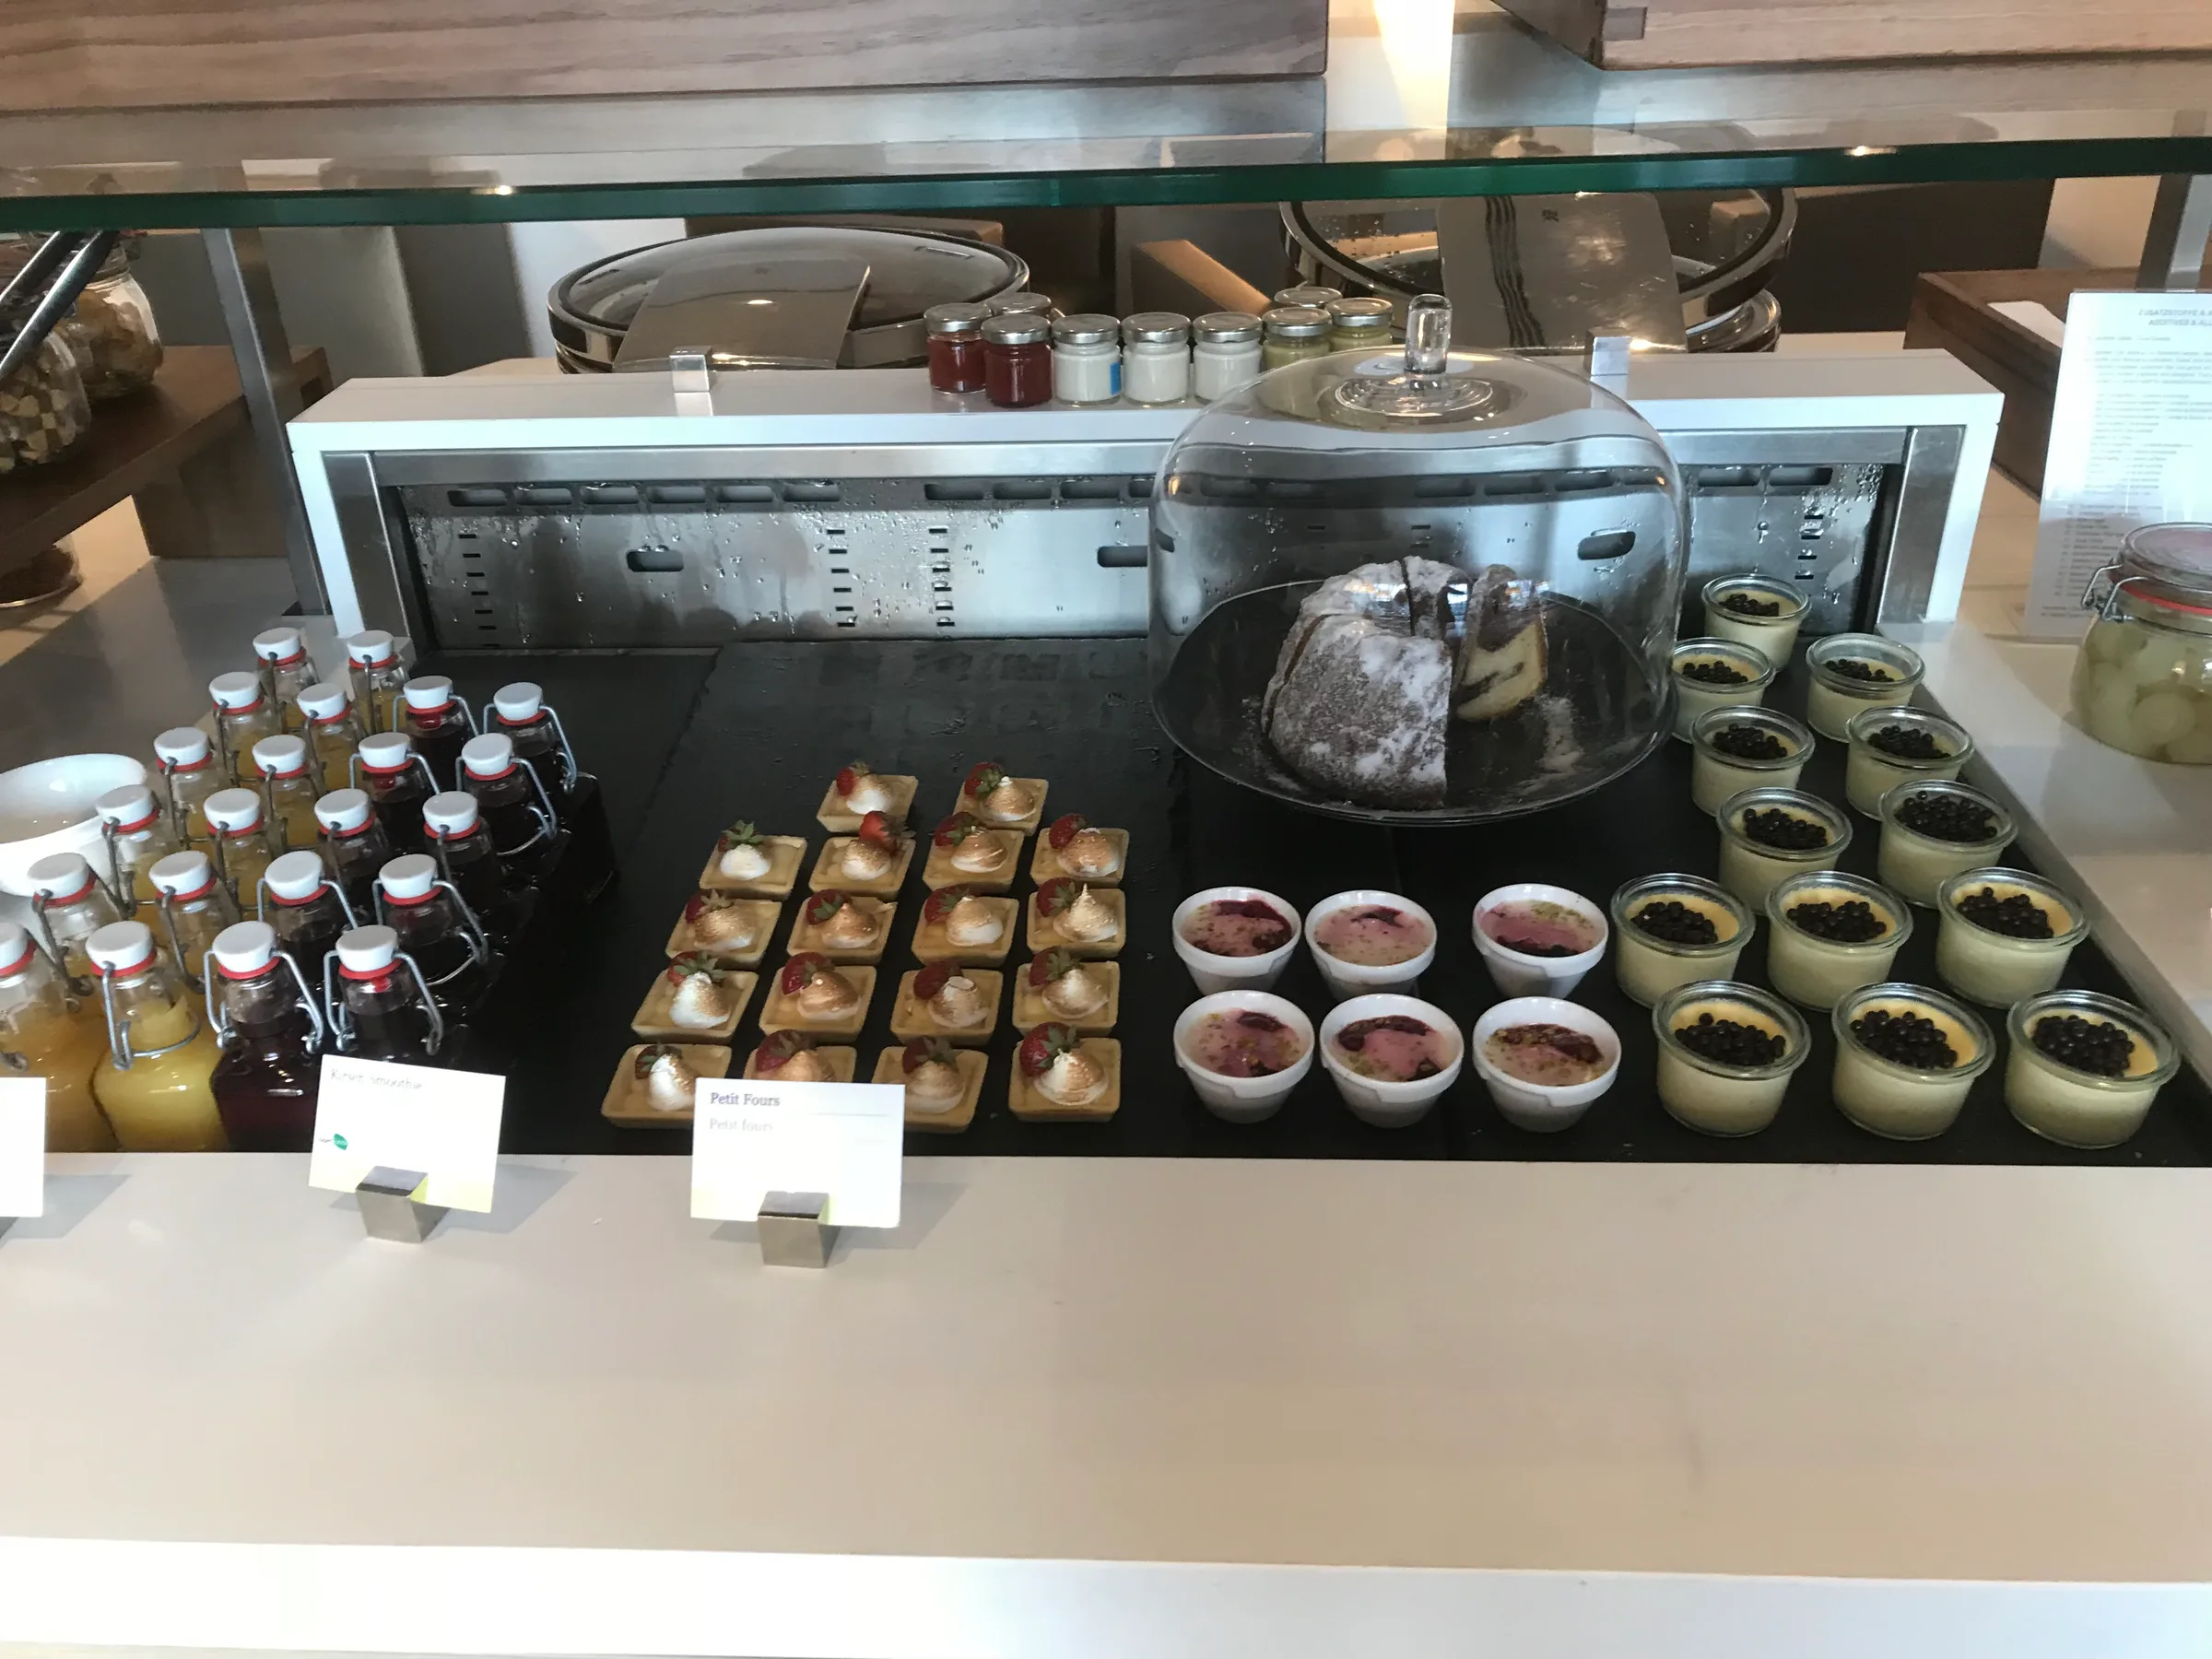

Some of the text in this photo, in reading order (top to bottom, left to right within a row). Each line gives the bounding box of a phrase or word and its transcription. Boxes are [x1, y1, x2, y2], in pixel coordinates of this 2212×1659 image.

[710, 1091, 780, 1106] Petit Fours
[709, 1117, 738, 1130] Petit
